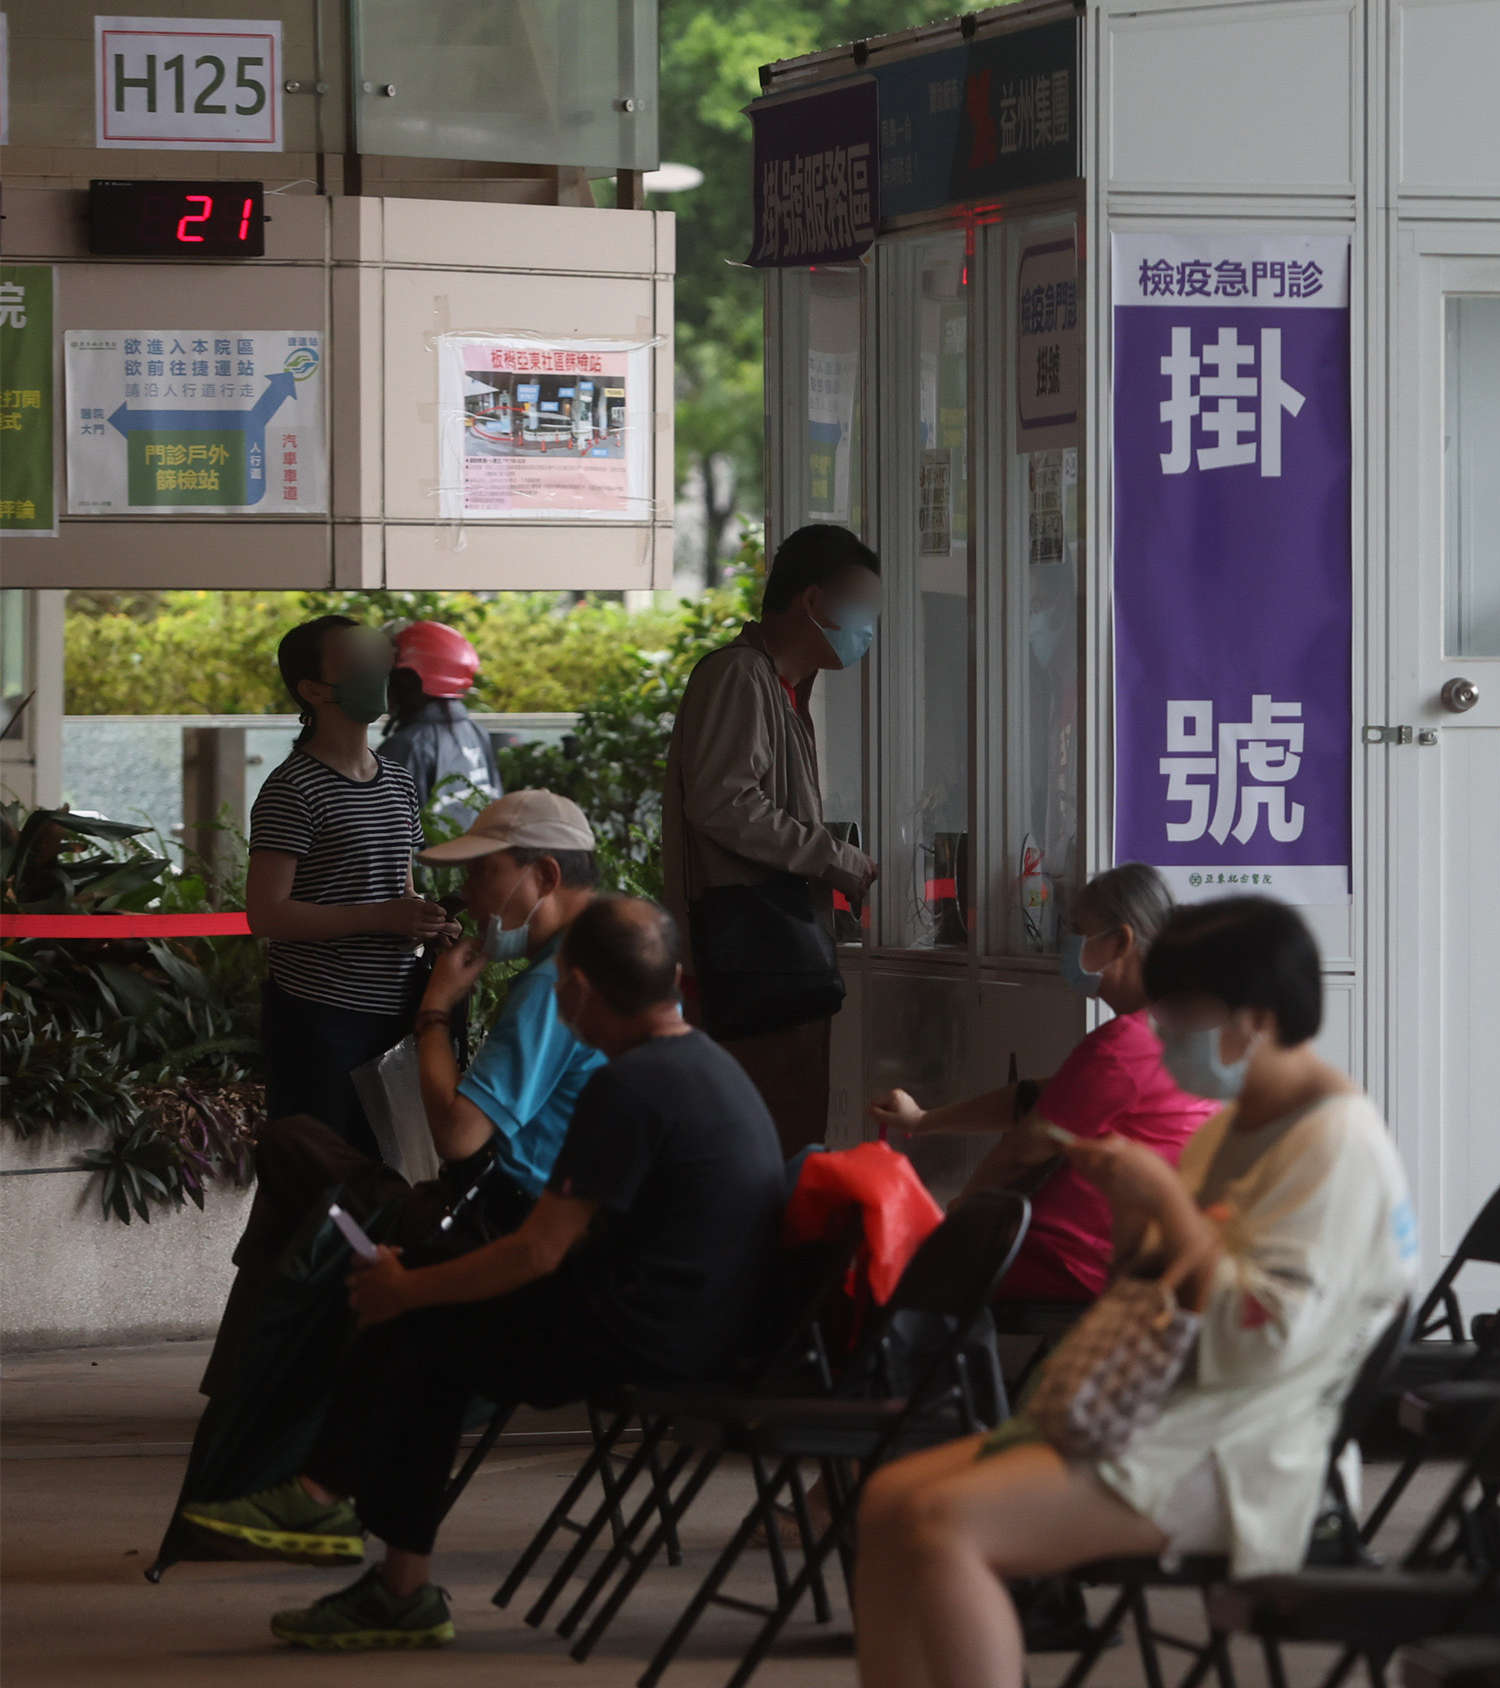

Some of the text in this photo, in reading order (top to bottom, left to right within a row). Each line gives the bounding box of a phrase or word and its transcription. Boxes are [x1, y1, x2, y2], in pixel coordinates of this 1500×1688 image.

[114, 54, 266, 116] H125
[759, 143, 871, 259] 掛號服務區
[176, 195, 253, 242] 21
[1138, 257, 1324, 299] 檢疫急門診
[124, 338, 254, 355] 欲進入本院區
[124, 359, 255, 377] 欲前往捷運站
[124, 383, 255, 398] 請沿人行道行走
[80, 423, 105, 435] 大門
[145, 444, 230, 466] 門診戶外
[249, 442, 262, 480] 人行道
[282, 433, 298, 501] 汽車車道
[156, 469, 220, 491] 篩檢站
